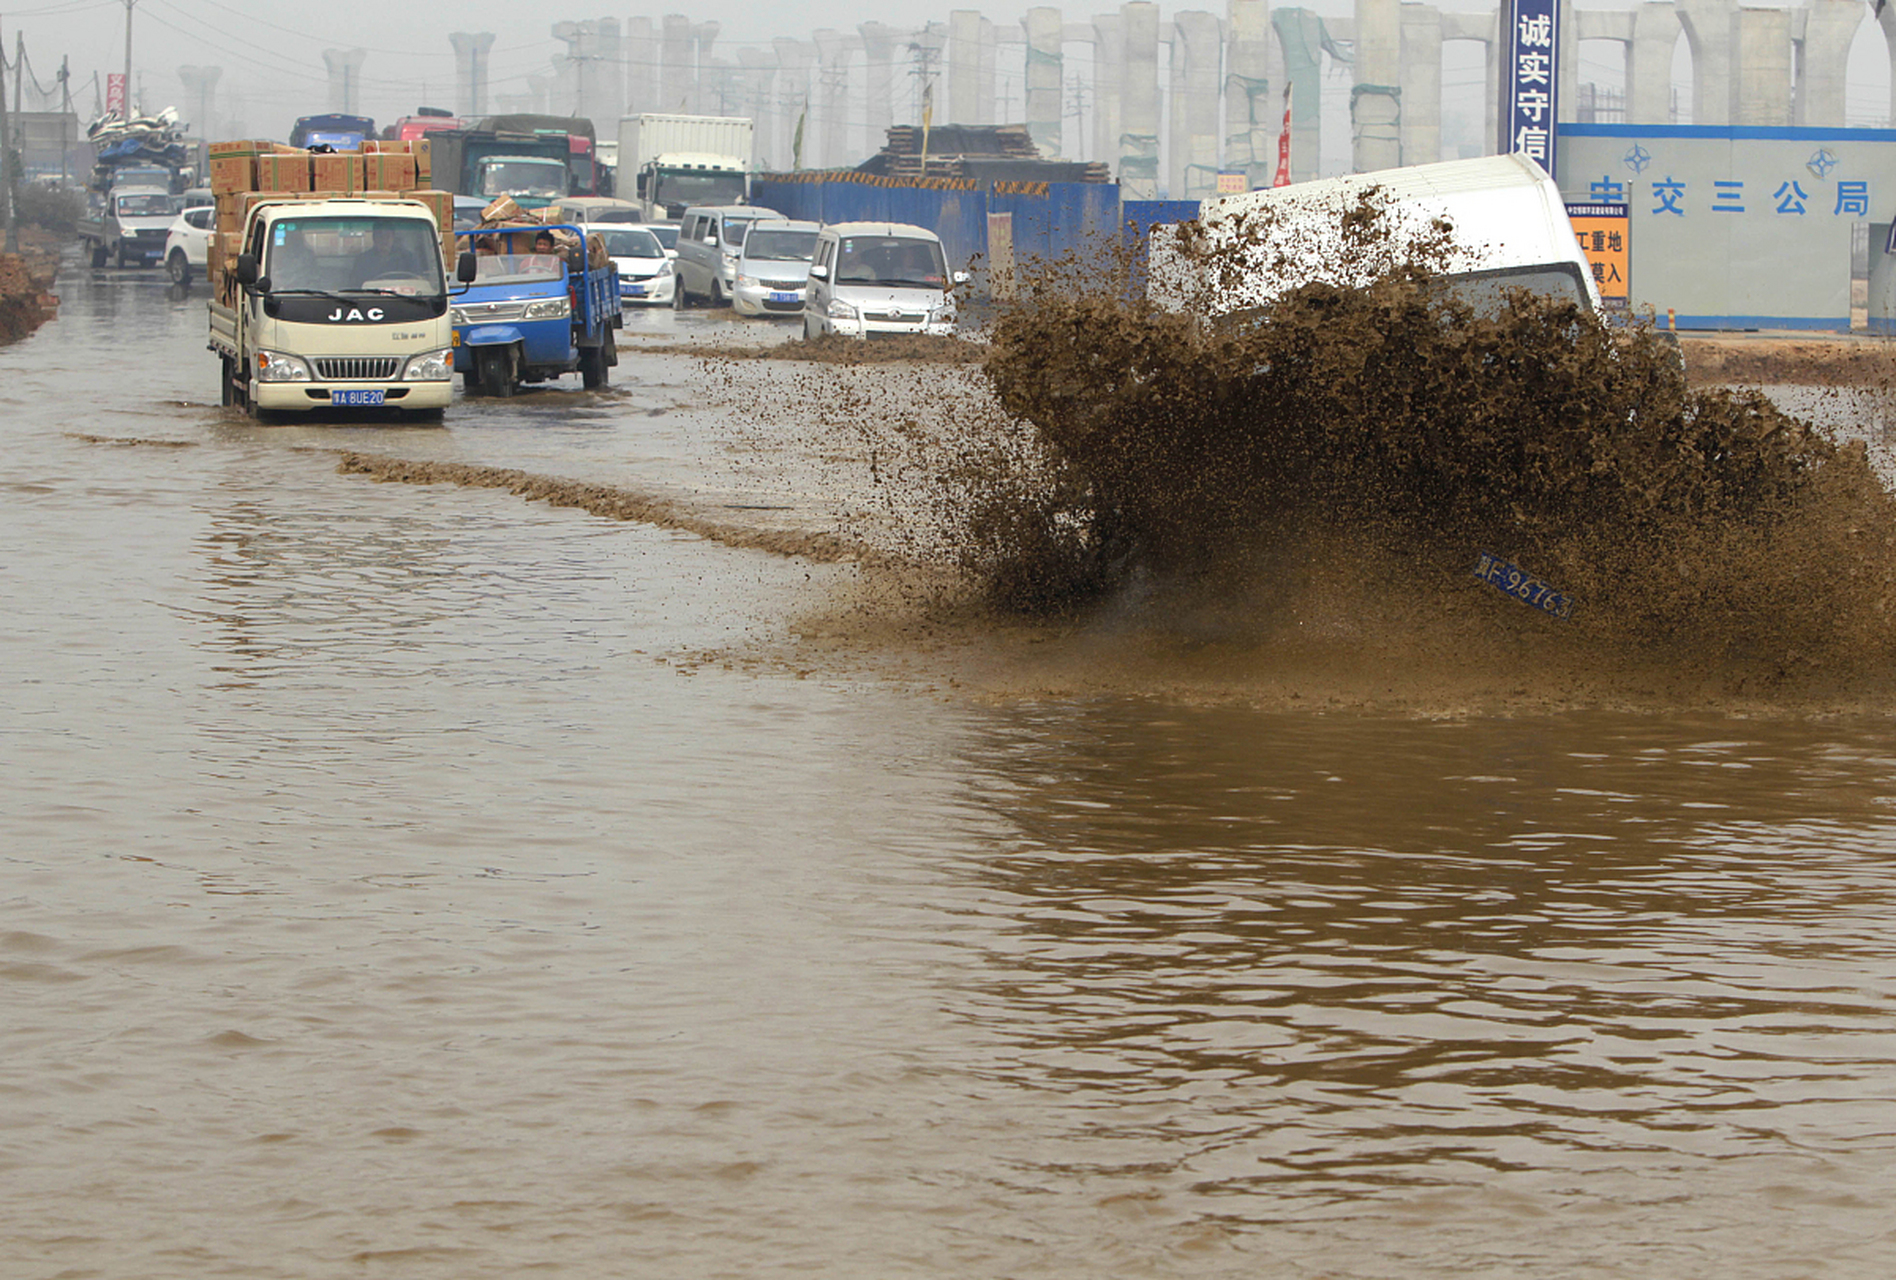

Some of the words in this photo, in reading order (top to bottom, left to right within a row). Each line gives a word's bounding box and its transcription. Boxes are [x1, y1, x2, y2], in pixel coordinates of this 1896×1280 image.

[1516, 14, 1551, 160] 诚实守信
[1590, 176, 1869, 217] 中交三公局
[328, 308, 384, 321] JAC
